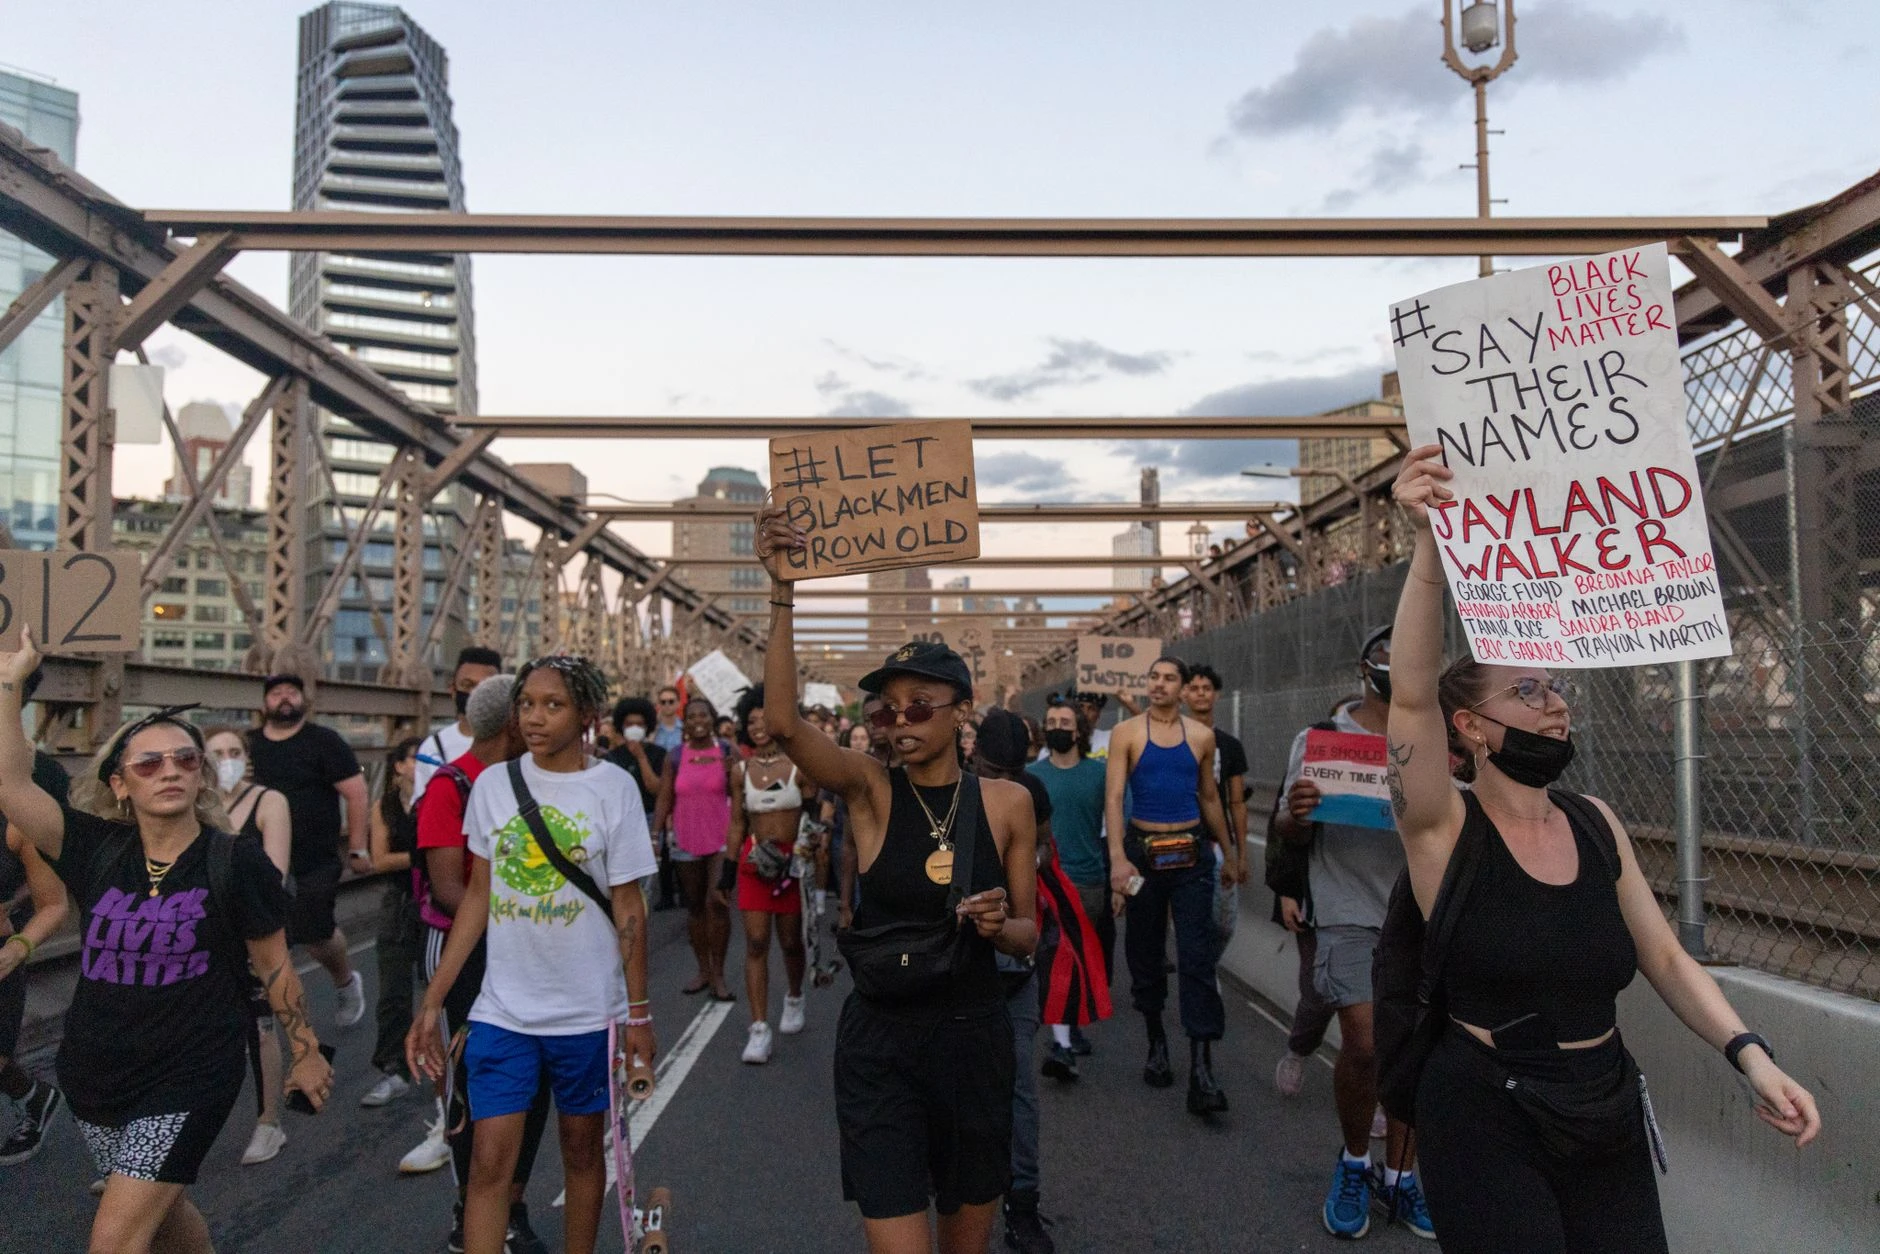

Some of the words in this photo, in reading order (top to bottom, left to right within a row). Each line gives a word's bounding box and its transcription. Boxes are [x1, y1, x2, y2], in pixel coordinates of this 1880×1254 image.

[1547, 251, 1649, 297] BLACK
[1556, 284, 1643, 322] LIVES
[1547, 304, 1672, 351] MATTER
[1465, 350, 1649, 413] THEIR
[1436, 396, 1640, 468] NAMES
[783, 436, 940, 493] #LET
[1436, 466, 1693, 544] JAYLAND
[1444, 518, 1687, 582] WALKER
[1456, 581, 1512, 601] GEORGE
[1513, 580, 1562, 603] FLOYD
[1574, 567, 1655, 595] BREONNA
[1656, 552, 1715, 580] TAYLOR
[1458, 600, 1510, 620] AHMAUD
[1511, 600, 1561, 621] ARBERY
[1572, 588, 1651, 618] MICHAEL
[1654, 576, 1716, 607] BROWN
[1464, 618, 1515, 638] TAMIR
[1515, 619, 1549, 639] RICE
[1560, 613, 1622, 637] SANDRA
[1624, 605, 1685, 630] BLAND
[1568, 629, 1645, 661] TRAYVON
[1649, 614, 1724, 652] MARTIN
[1101, 643, 1135, 659] NO
[1475, 637, 1508, 660] ERIC
[1508, 640, 1574, 662] GARNER
[1330, 746, 1383, 761] SHOULD
[1303, 766, 1343, 781] EVERY
[1349, 771, 1377, 785] TIME
[86, 914, 198, 955] LIVES
